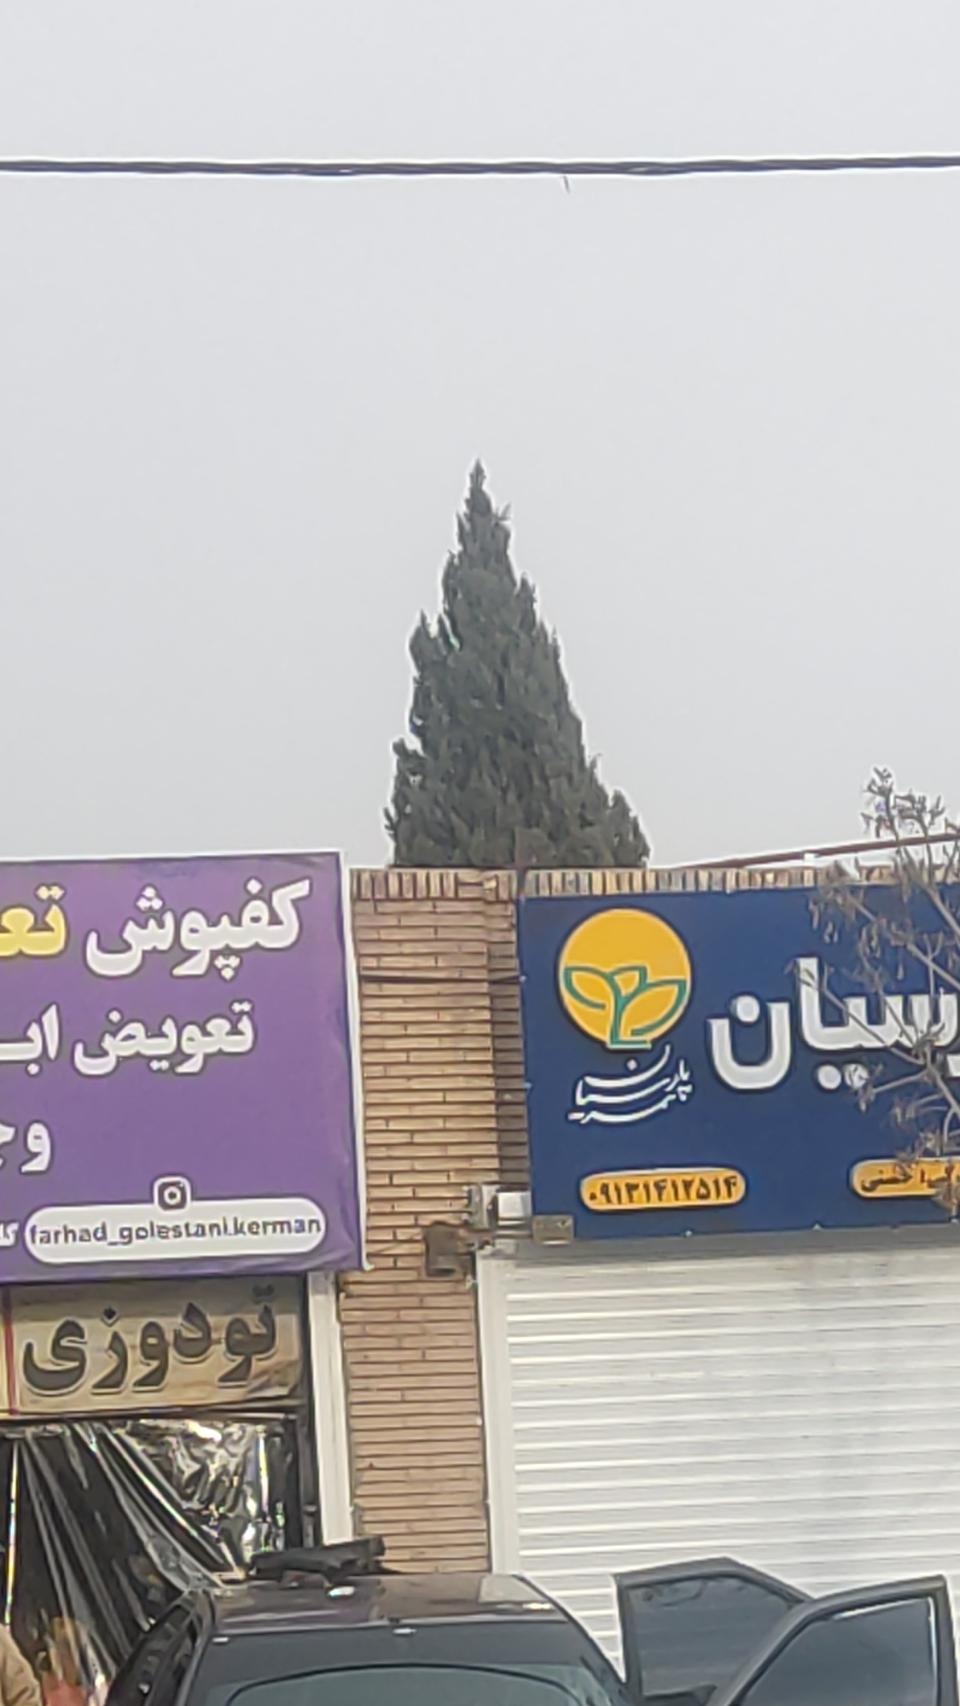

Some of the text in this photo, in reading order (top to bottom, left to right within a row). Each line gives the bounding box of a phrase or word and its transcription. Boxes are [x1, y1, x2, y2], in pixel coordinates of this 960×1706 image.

[85, 877, 311, 979] کفپوش
[73, 1000, 254, 1076] تعویض
[22, 1281, 277, 1394] تودوزی
